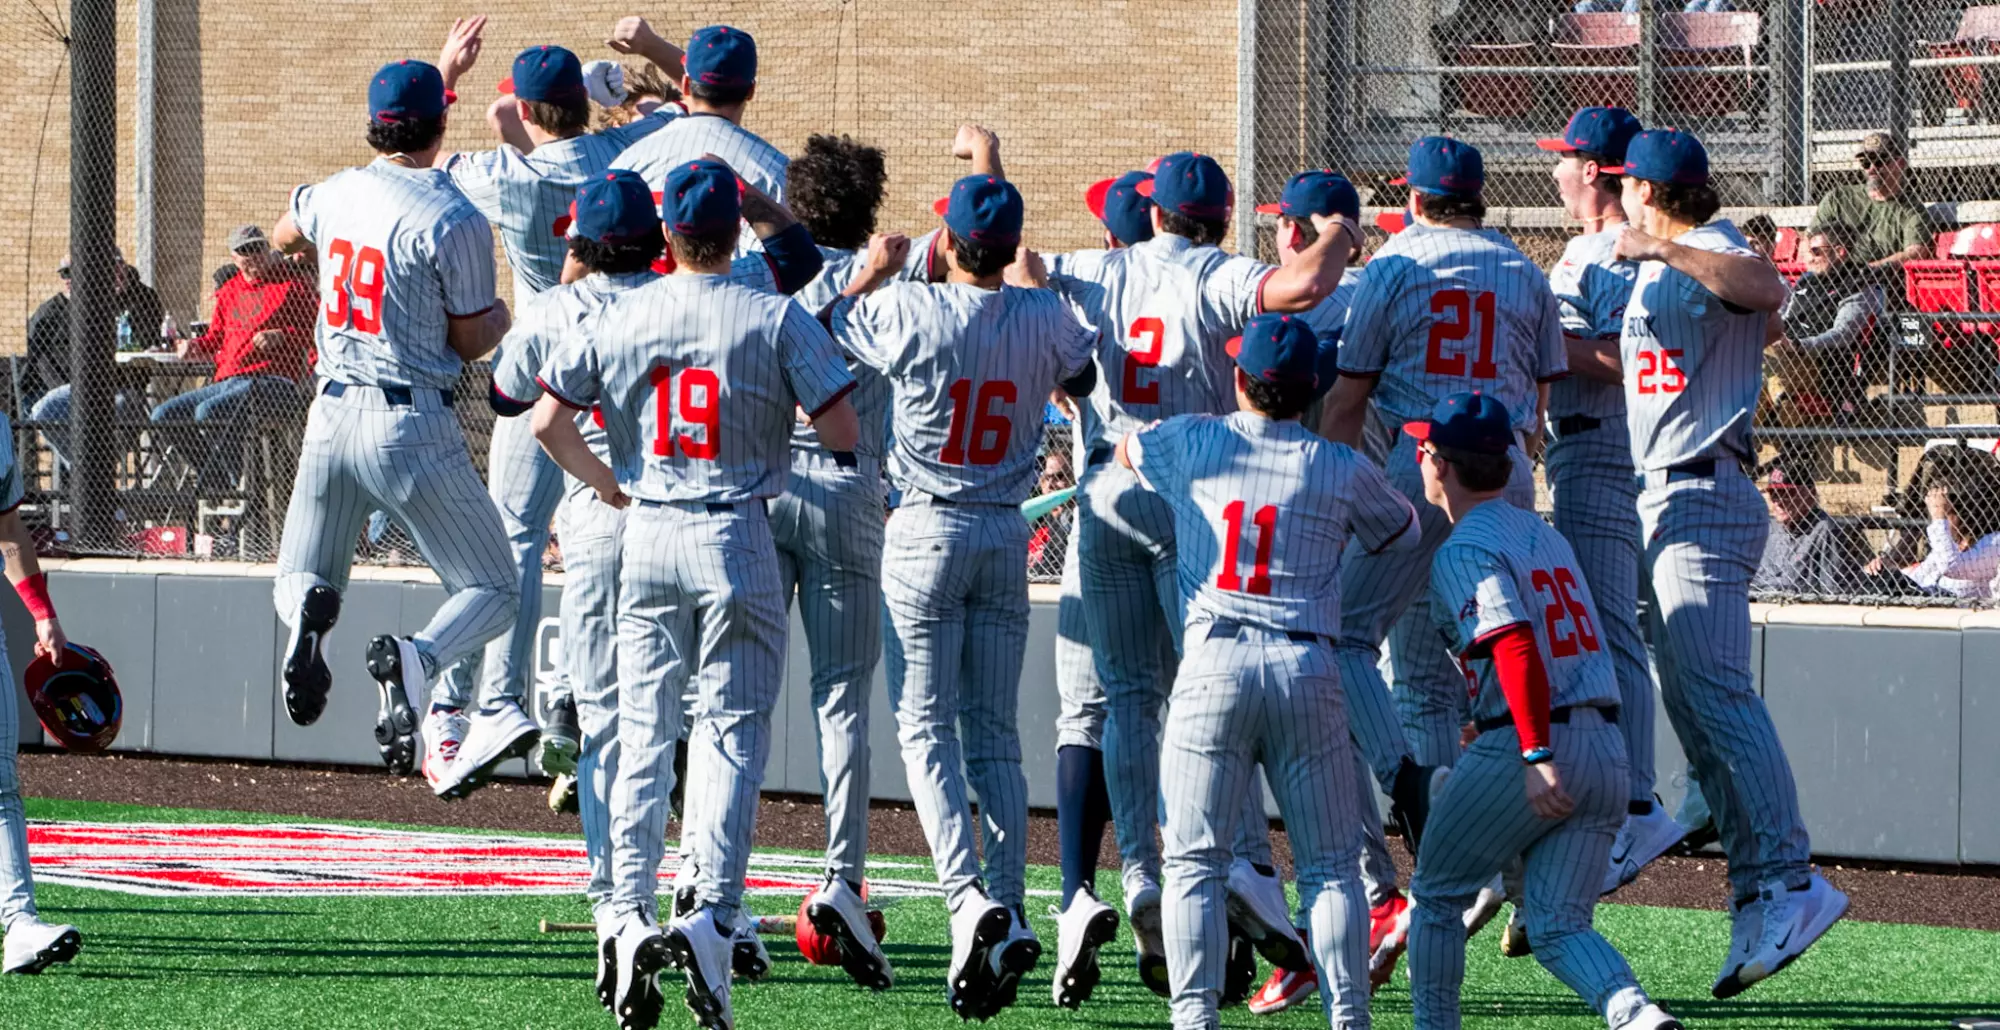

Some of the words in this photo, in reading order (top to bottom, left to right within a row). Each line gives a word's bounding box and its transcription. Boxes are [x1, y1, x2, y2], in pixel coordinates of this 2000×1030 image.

[325, 238, 386, 336] 39
[1122, 317, 1165, 405] 2
[1425, 290, 1497, 380] 21
[1637, 348, 1685, 395] 25
[651, 365, 720, 461] 19
[940, 379, 1018, 465] 16
[1215, 499, 1277, 595] 11
[1531, 567, 1600, 659] 26
